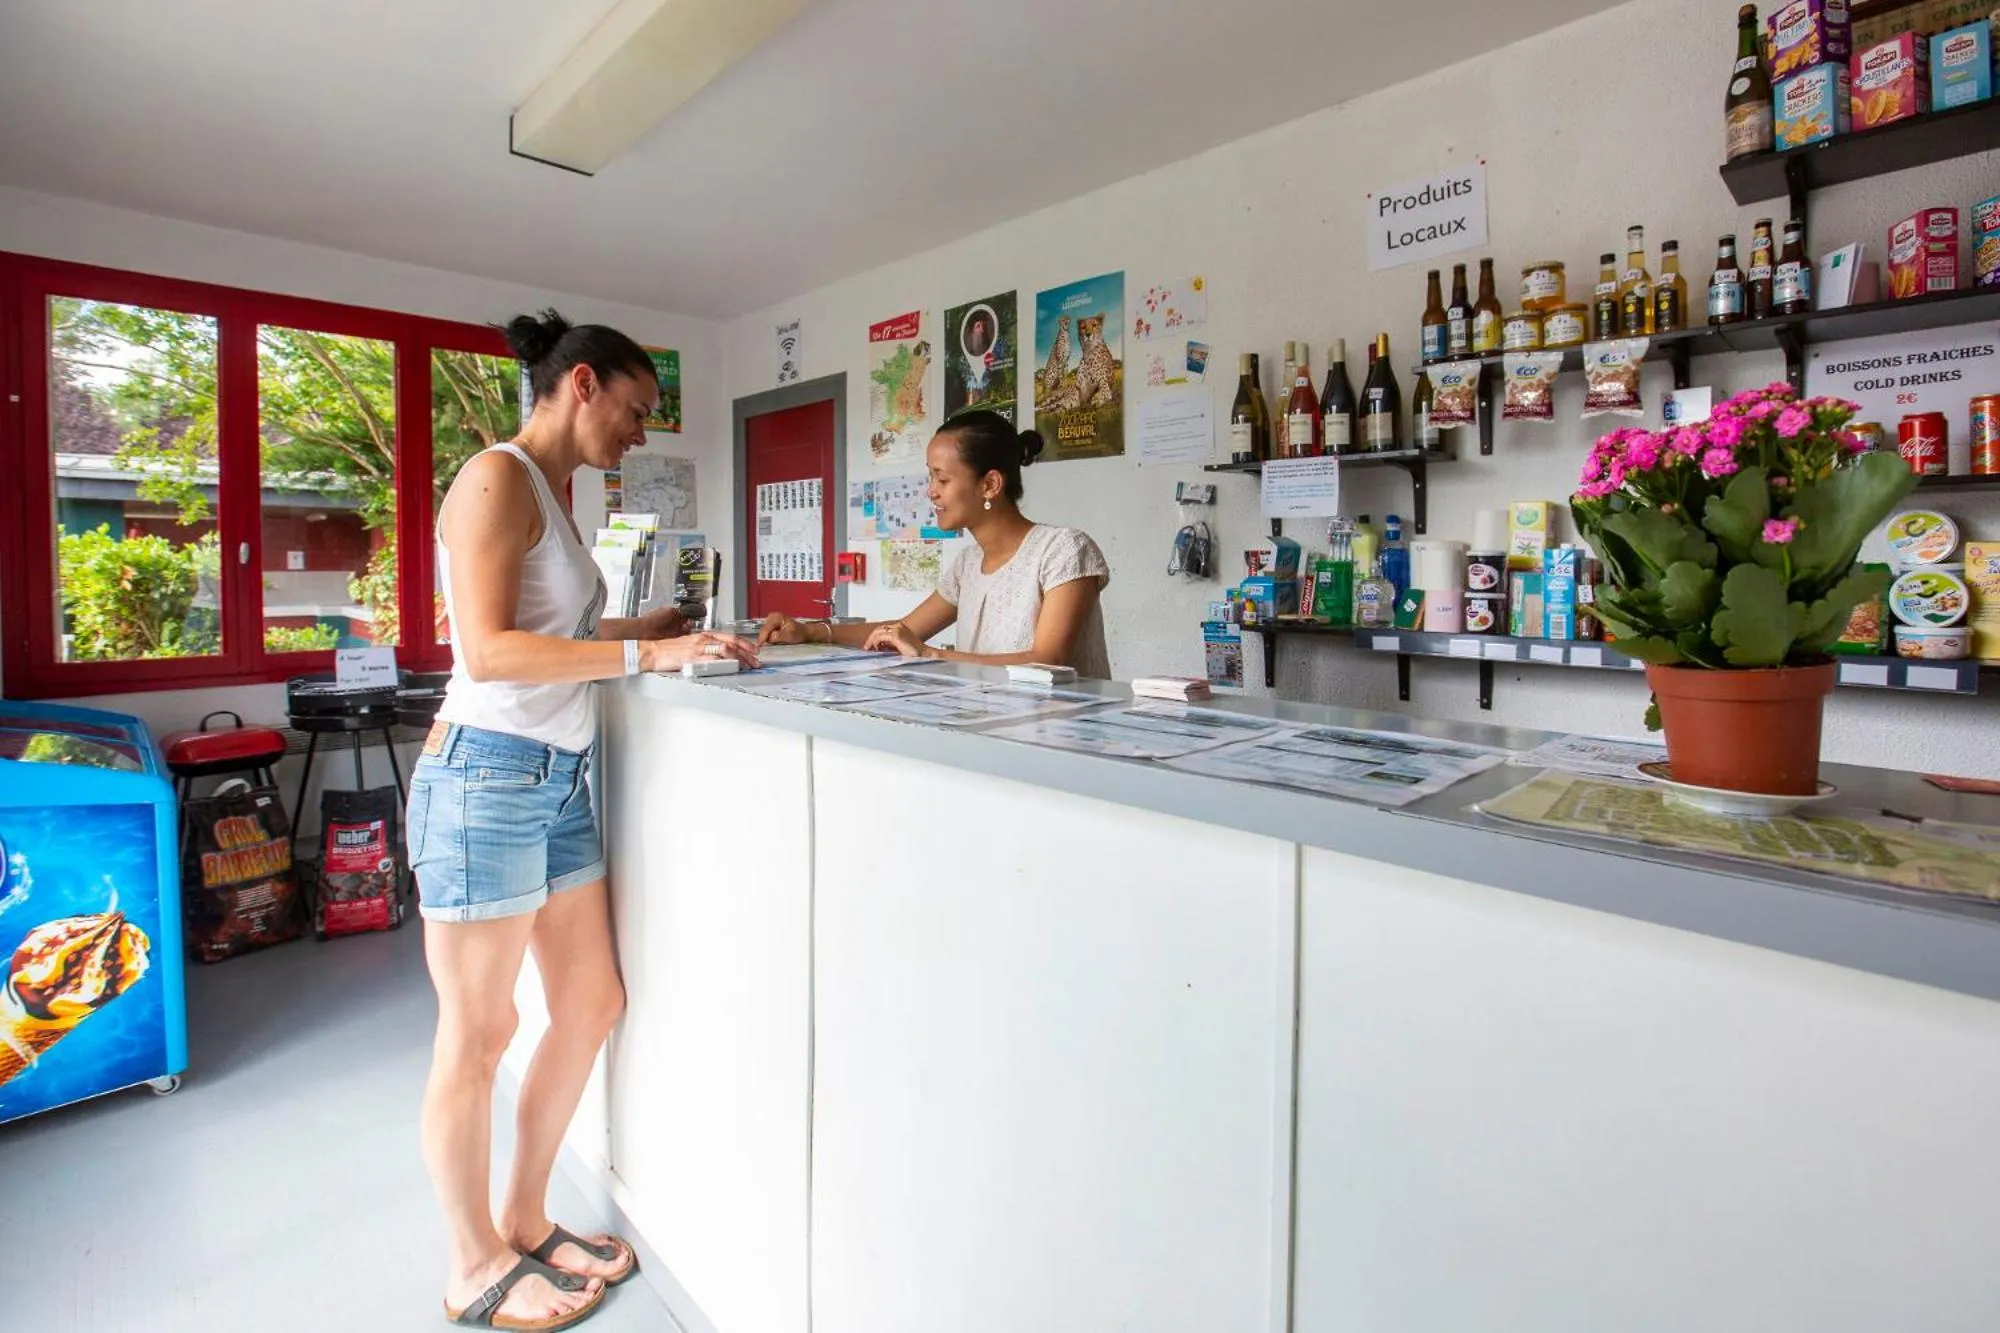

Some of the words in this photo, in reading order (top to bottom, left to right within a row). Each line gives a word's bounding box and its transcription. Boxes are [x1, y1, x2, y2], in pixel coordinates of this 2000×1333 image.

[1379, 178, 1472, 217] Produits
[1387, 217, 1467, 250] Locaux
[1825, 356, 1902, 374] BOISSONS
[1907, 344, 1995, 364] FRAICHES
[1854, 378, 1895, 392] COLD
[1900, 370, 1963, 387] DRINKS
[1896, 392, 1918, 405] 2€
[1058, 424, 1097, 439] BEAUVAL
[214, 815, 270, 850] GRILL
[338, 830, 370, 844] weber
[202, 836, 292, 889] BARBECUE
